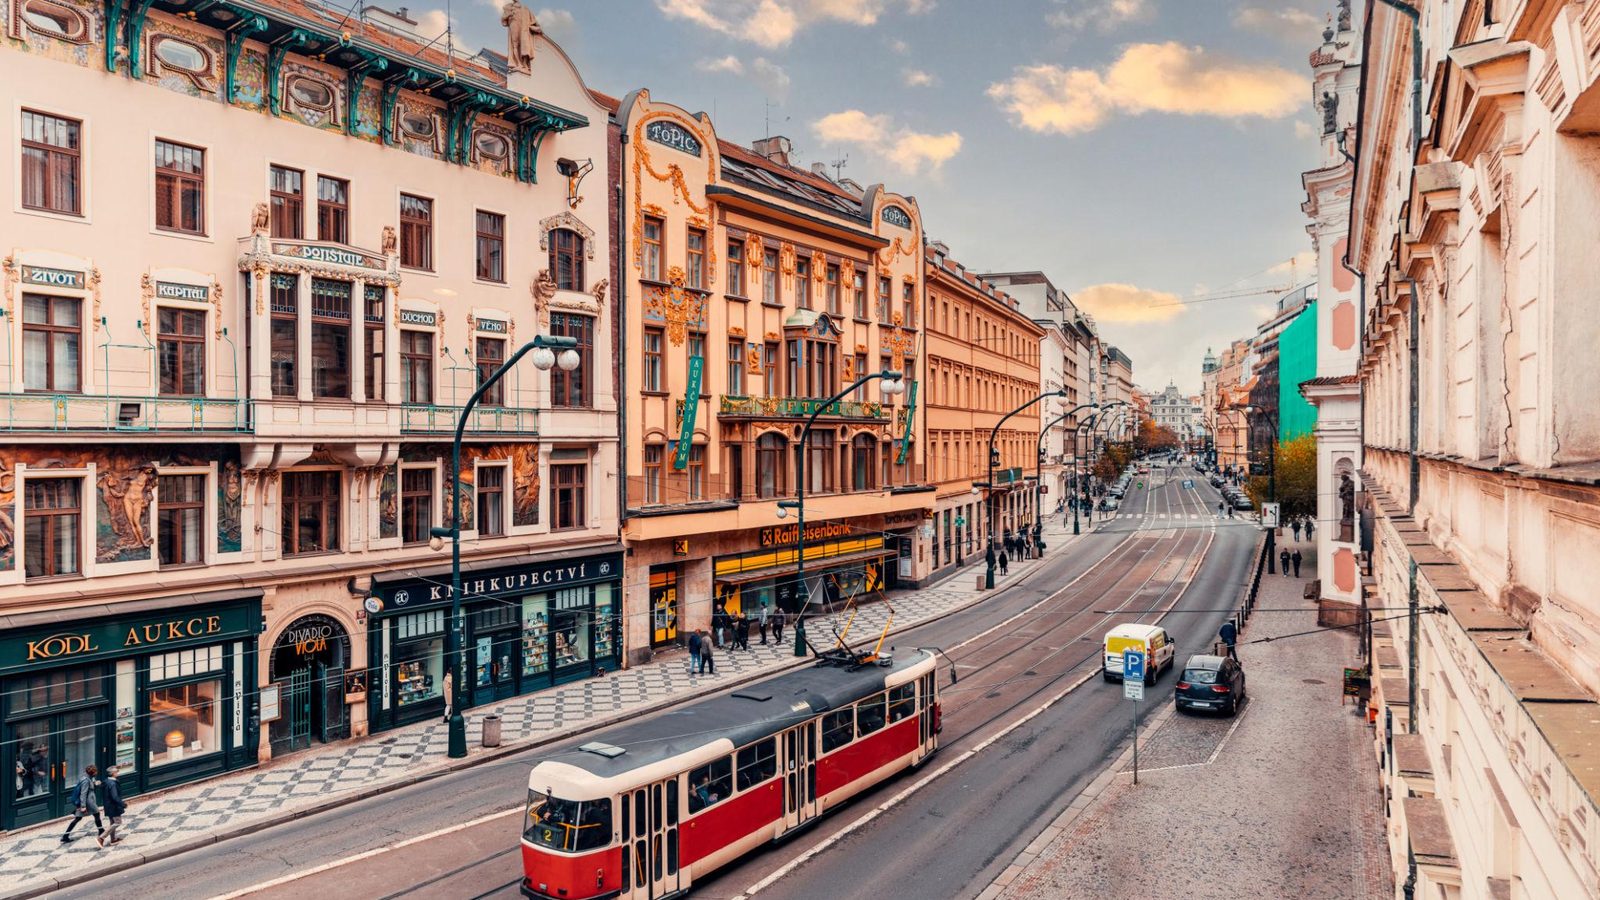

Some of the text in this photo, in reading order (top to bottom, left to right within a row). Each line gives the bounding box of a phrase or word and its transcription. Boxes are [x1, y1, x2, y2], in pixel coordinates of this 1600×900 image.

[774, 519, 851, 544] Raiffeisenbank
[430, 563, 585, 600] KNIHKUPECTVÍ
[27, 616, 221, 660] KODL AUKCE
[1127, 654, 1140, 671] P
[544, 829, 552, 842] 2
